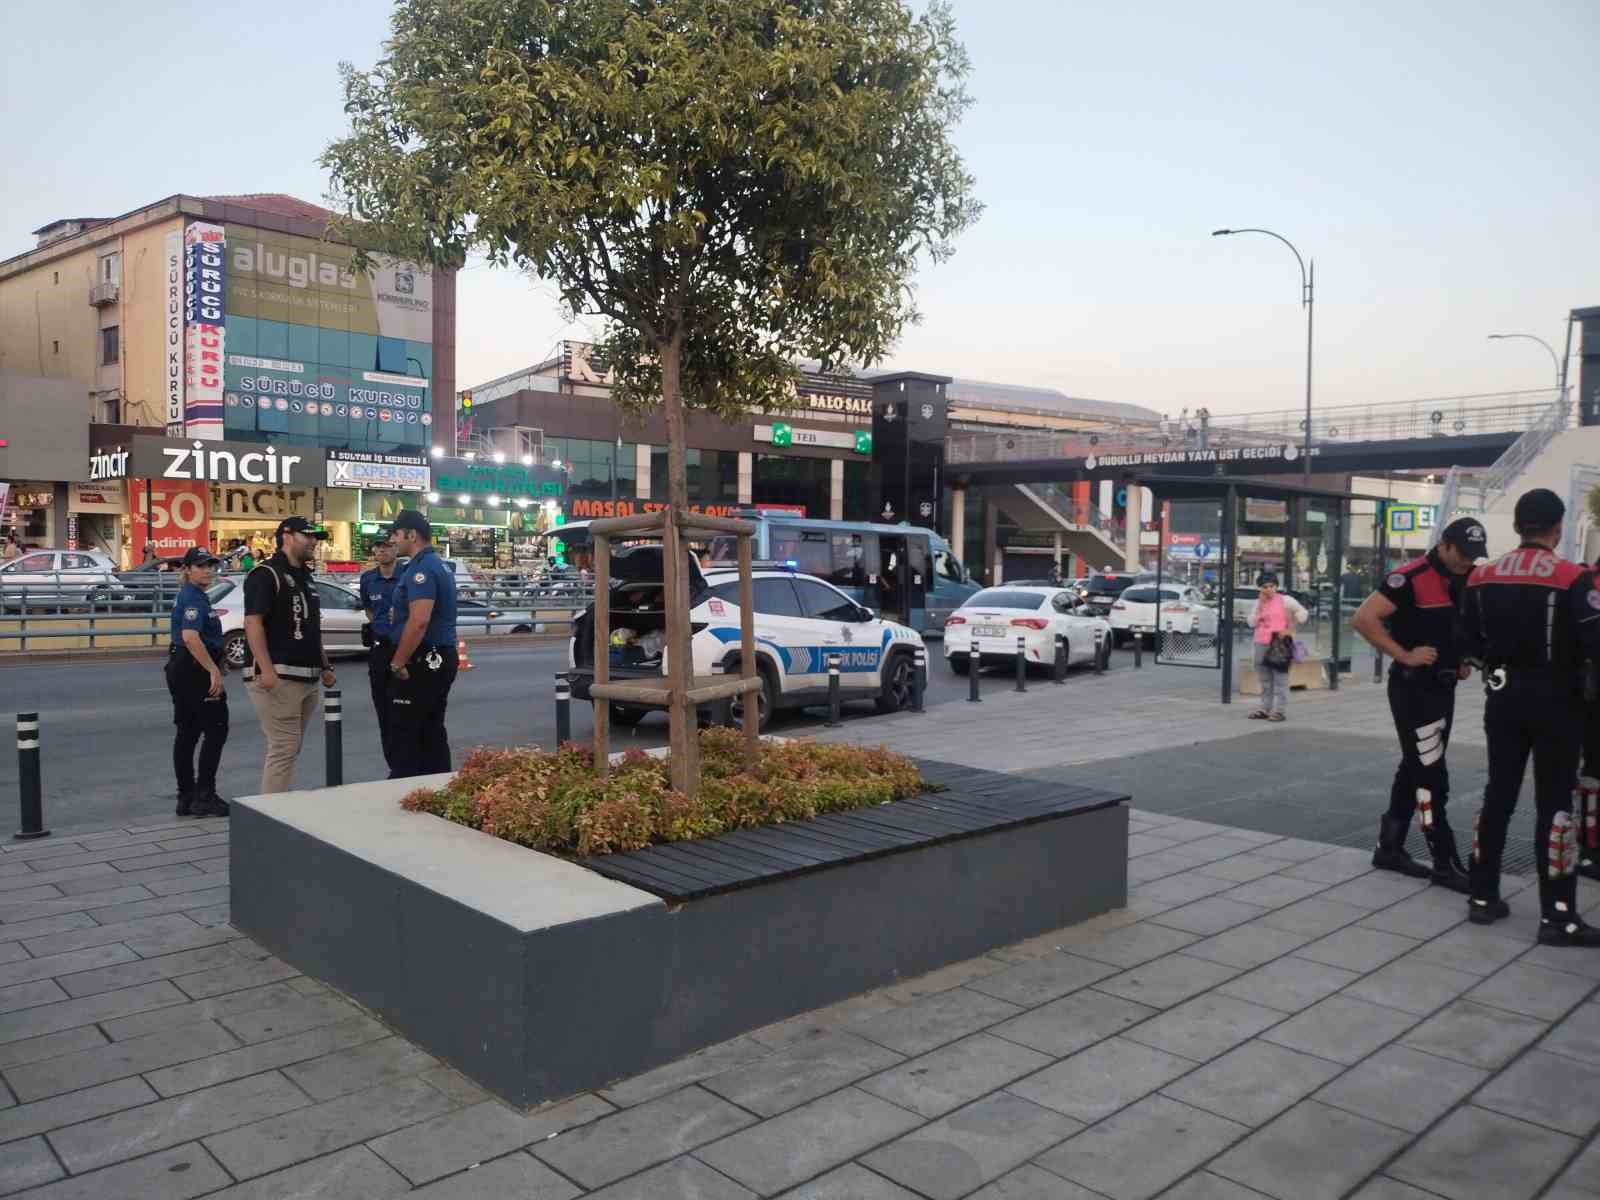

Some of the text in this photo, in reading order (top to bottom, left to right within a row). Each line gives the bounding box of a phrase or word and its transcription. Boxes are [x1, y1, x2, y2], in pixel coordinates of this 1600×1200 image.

[234, 243, 358, 289] aluglas
[169, 352, 179, 420] KURSU
[240, 375, 336, 399] SÜRÜCÜ
[349, 387, 422, 409] KURSU
[809, 393, 843, 410] BALO
[90, 446, 129, 479] zincir
[162, 439, 302, 484] zincir
[1144, 453, 1185, 465] MEYDAN
[1188, 450, 1216, 462] YAYA
[572, 499, 635, 518] MASAL
